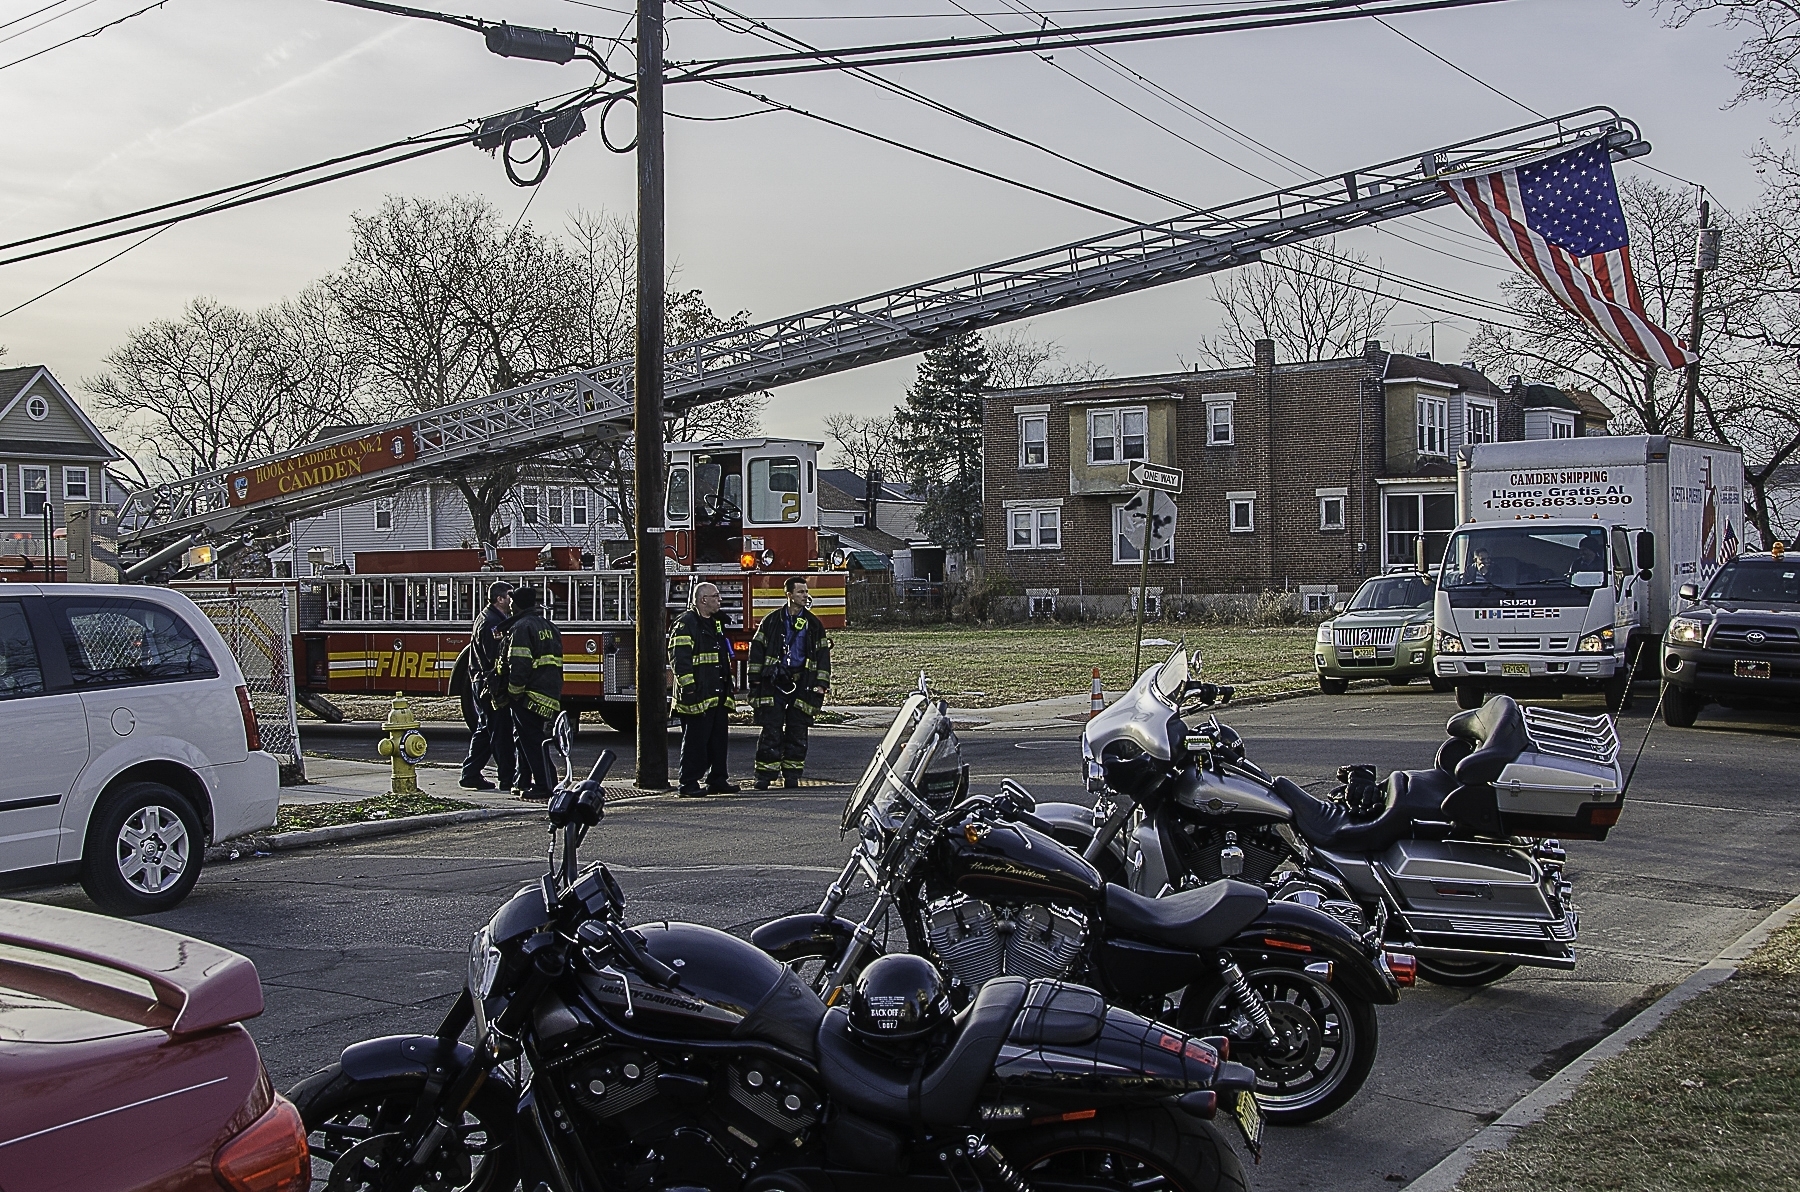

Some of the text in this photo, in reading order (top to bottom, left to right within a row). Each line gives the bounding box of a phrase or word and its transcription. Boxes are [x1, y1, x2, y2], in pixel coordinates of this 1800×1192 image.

[255, 466, 285, 484] HOOK
[287, 461, 295, 472] &
[297, 448, 338, 468] LADDER
[376, 436, 382, 452] 2
[278, 457, 362, 493] CAMDEN
[1144, 470, 1176, 485] ONE WAY
[1510, 472, 1559, 486] CAMDEN
[1560, 470, 1608, 484] SHIPPING
[1483, 494, 1633, 509] 1.866.863.9590
[1492, 489, 1543, 499] Llame
[1548, 486, 1601, 497] Gratis
[781, 493, 799, 521] 2
[376, 651, 438, 678] FIRE
[969, 861, 1050, 881] Harley-Davidson
[871, 1009, 899, 1017] BACK OFF
